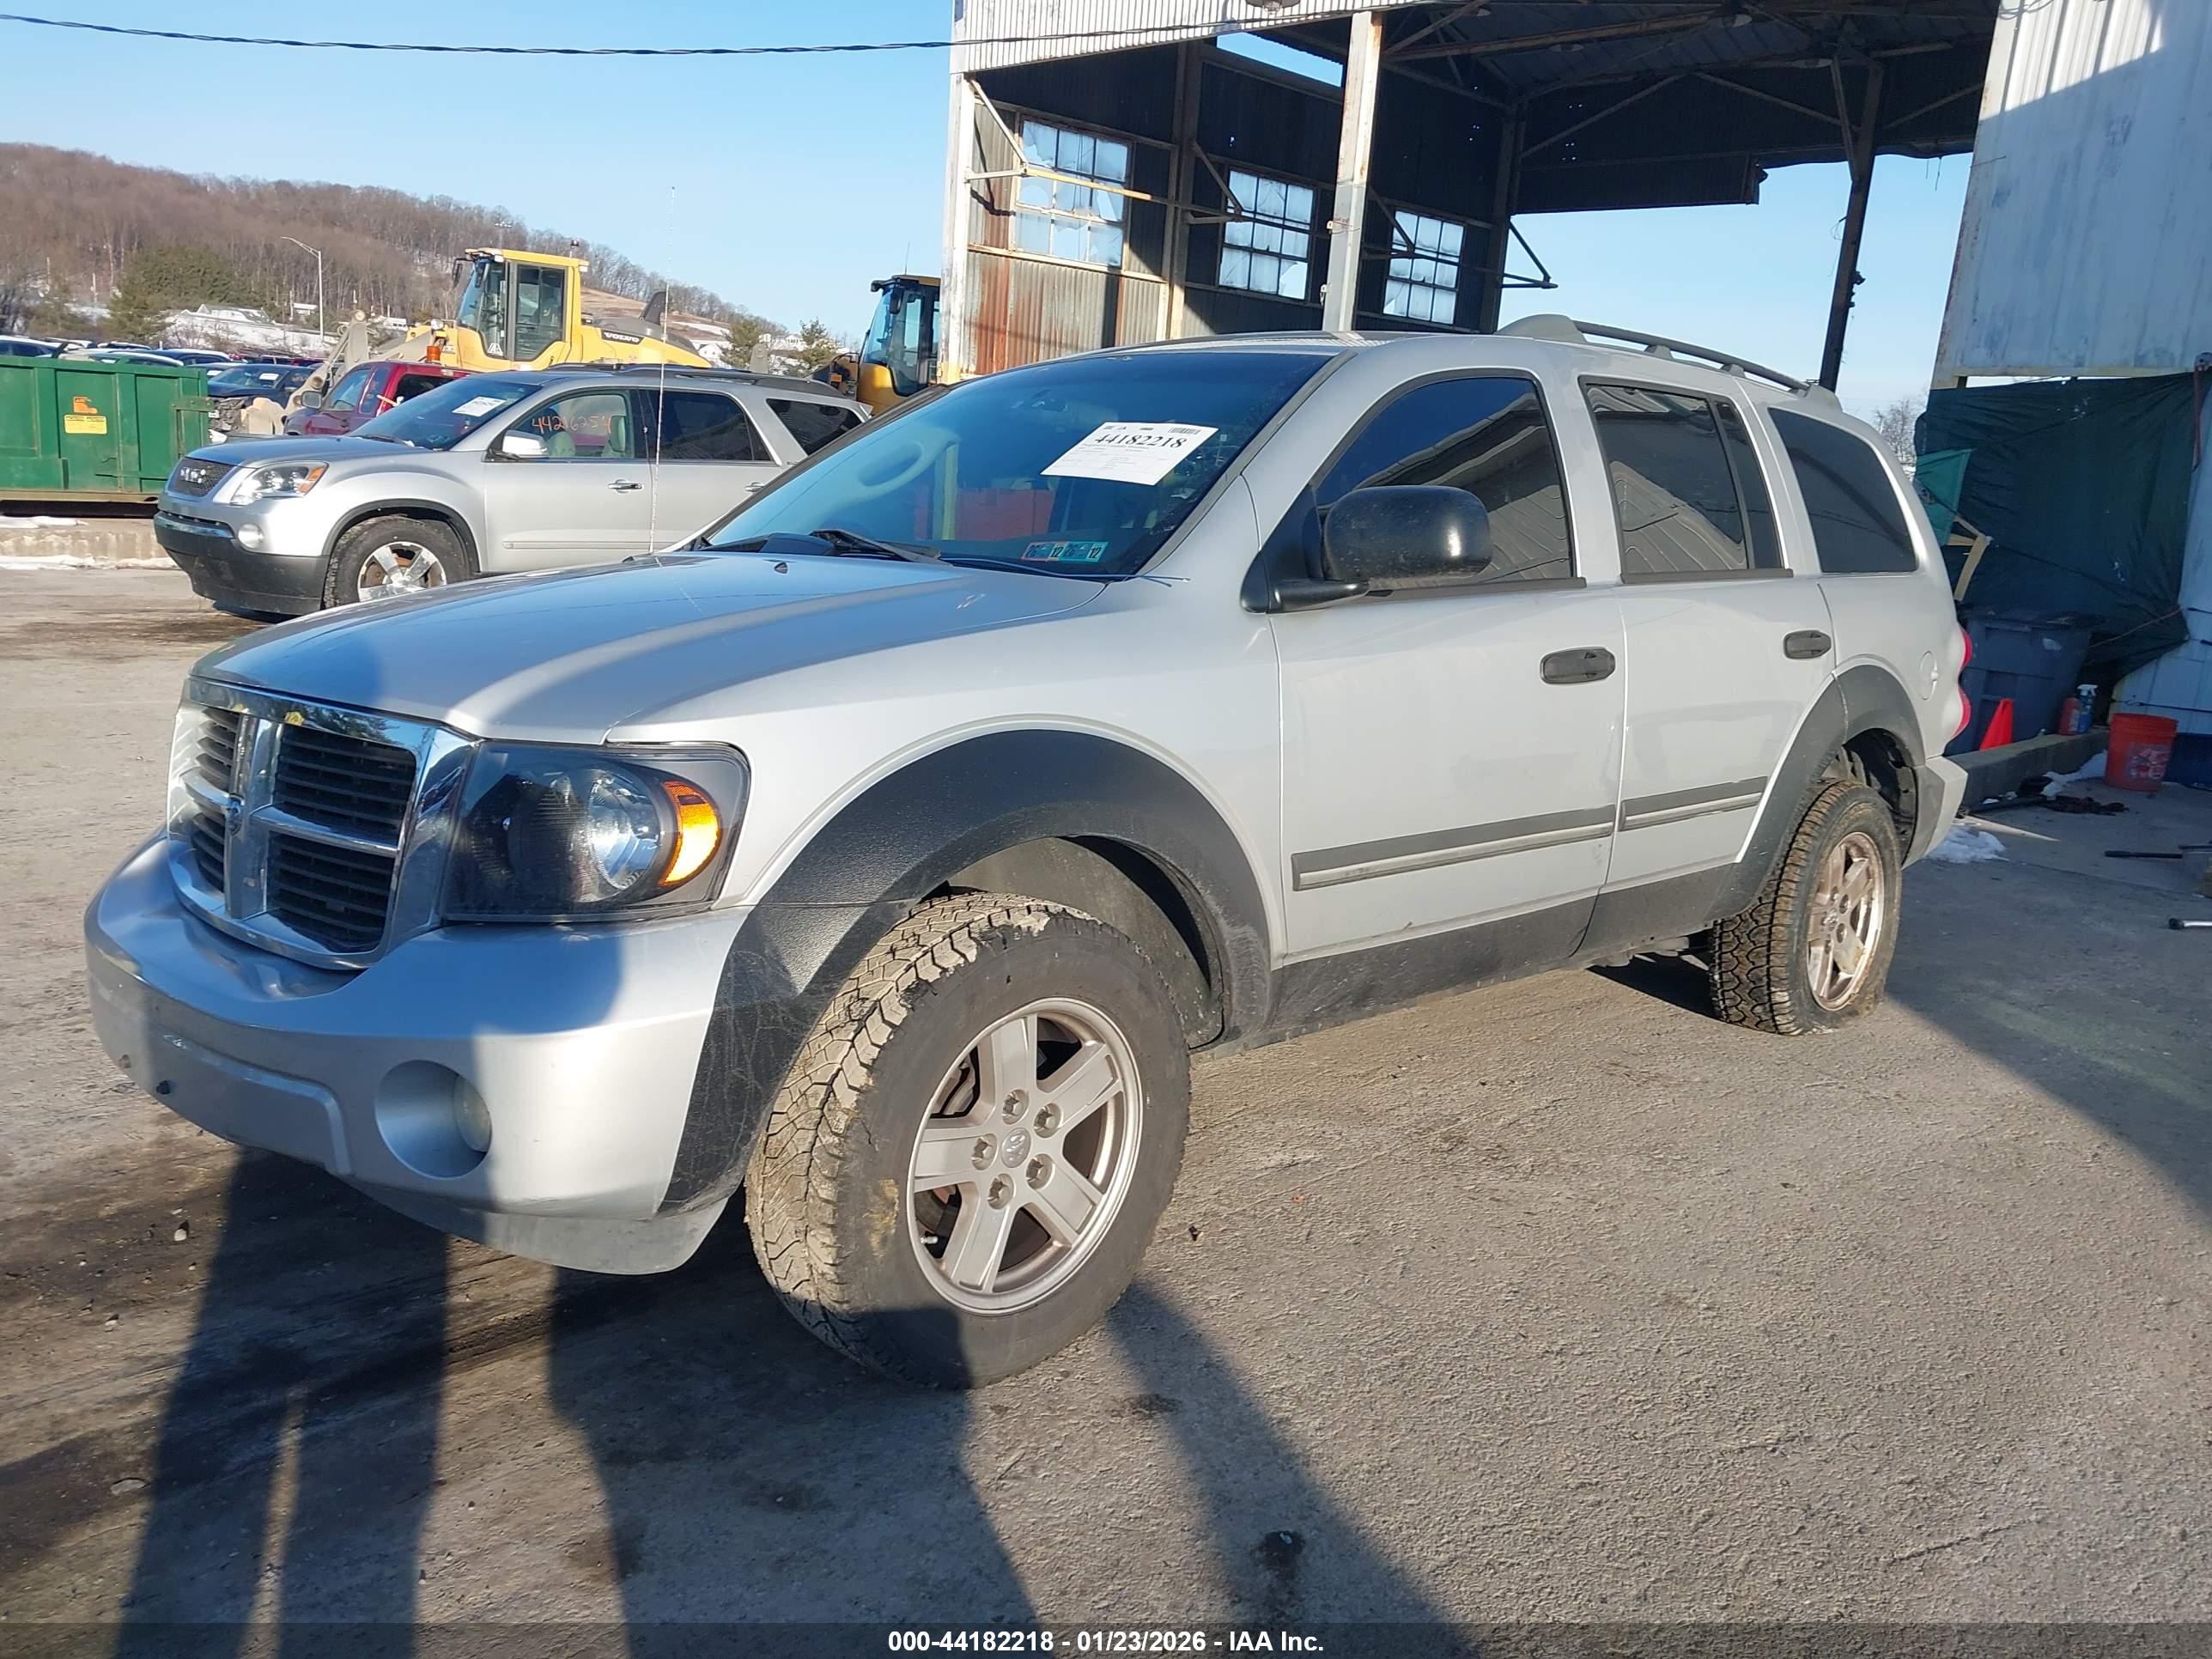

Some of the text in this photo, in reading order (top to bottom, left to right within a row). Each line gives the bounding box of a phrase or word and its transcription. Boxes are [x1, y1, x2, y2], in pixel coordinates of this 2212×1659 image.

[604, 331, 640, 343] VOLVO
[1094, 433, 1188, 448] 44182218
[1050, 546, 1065, 558] 12
[1088, 547, 1101, 559] 12
